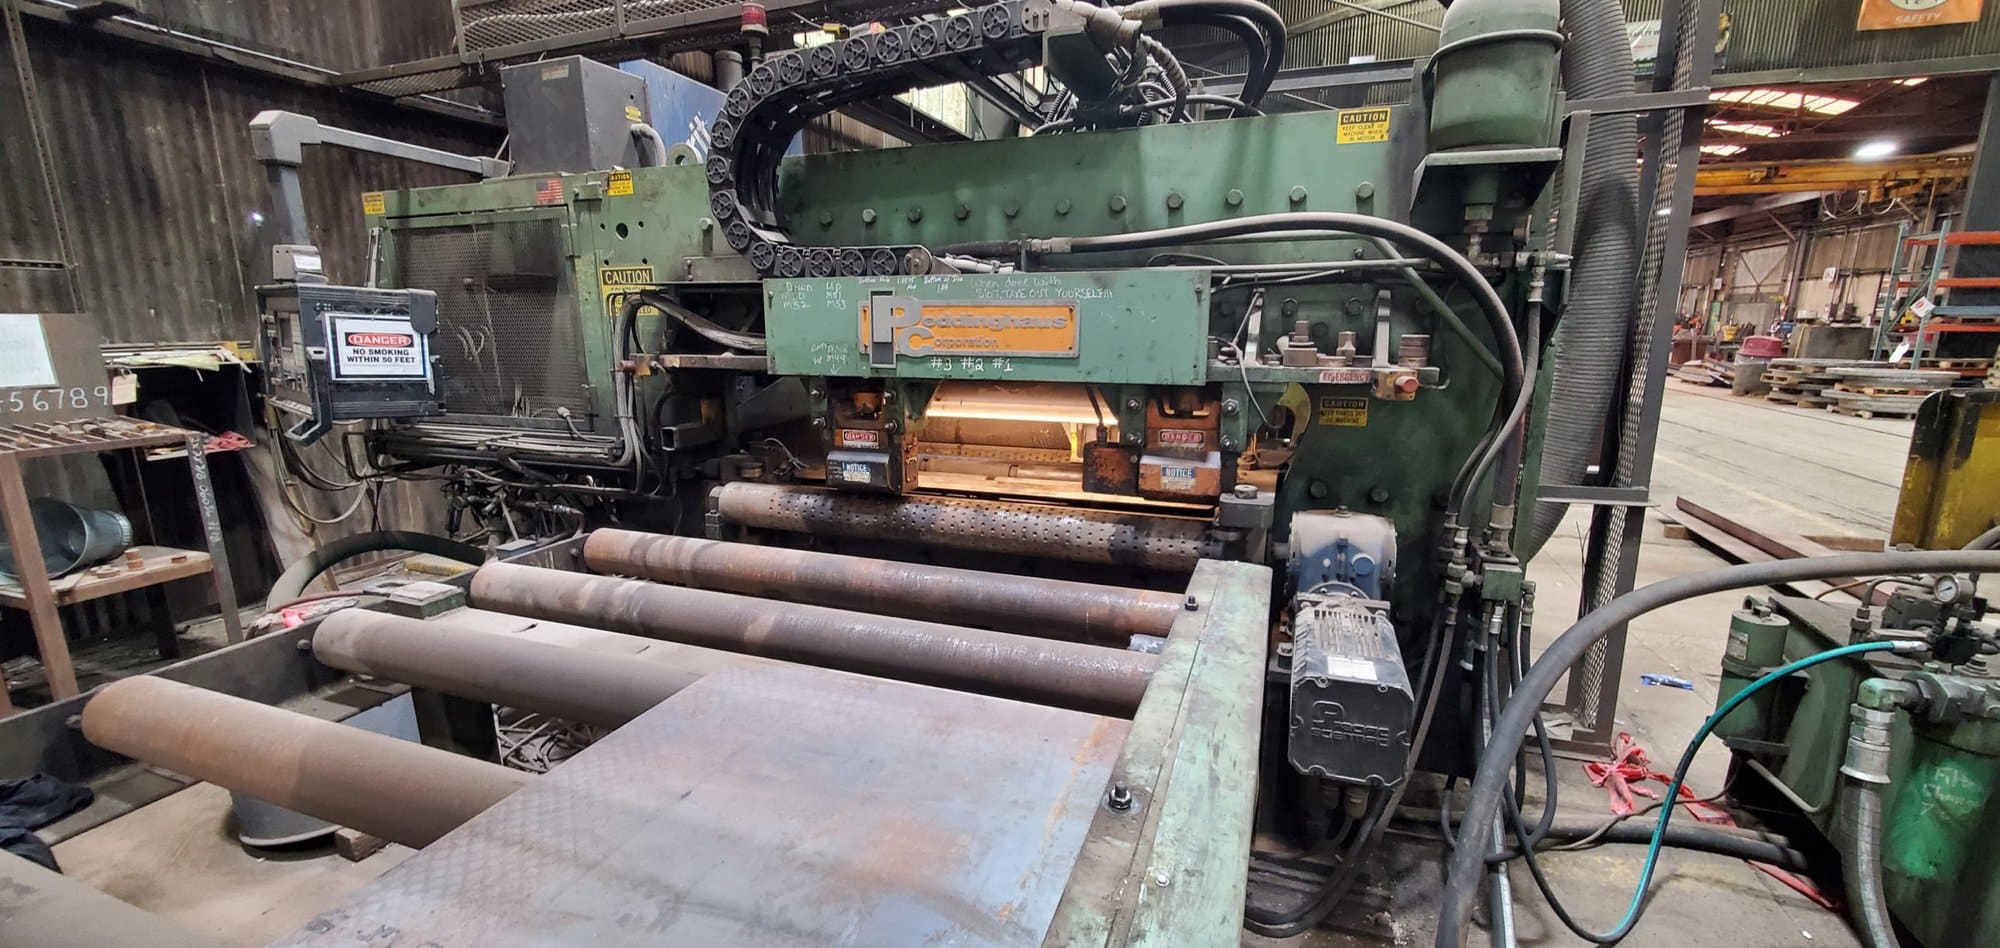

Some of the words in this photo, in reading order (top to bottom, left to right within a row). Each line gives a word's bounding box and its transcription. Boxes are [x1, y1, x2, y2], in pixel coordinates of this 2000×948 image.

[1895, 13, 1942, 24] SAFETY
[1343, 111, 1386, 123] CAUTION
[605, 270, 650, 285] CAUTION
[873, 296, 1068, 342] Peddinghaus
[352, 335, 409, 346] DANGER
[897, 327, 1000, 356] Corporation
[352, 348, 366, 356] NO
[368, 348, 410, 356] SMOKING
[395, 356, 415, 364] FEET
[929, 356, 953, 372] #3
[960, 356, 985, 372] #2
[991, 357, 1015, 372] #1
[0, 386, 108, 412] 56789
[1324, 400, 1365, 408] CAUTION
[1164, 432, 1200, 442] DANGER
[846, 463, 868, 472] NOTICE
[1166, 467, 1194, 478] NOTICE
